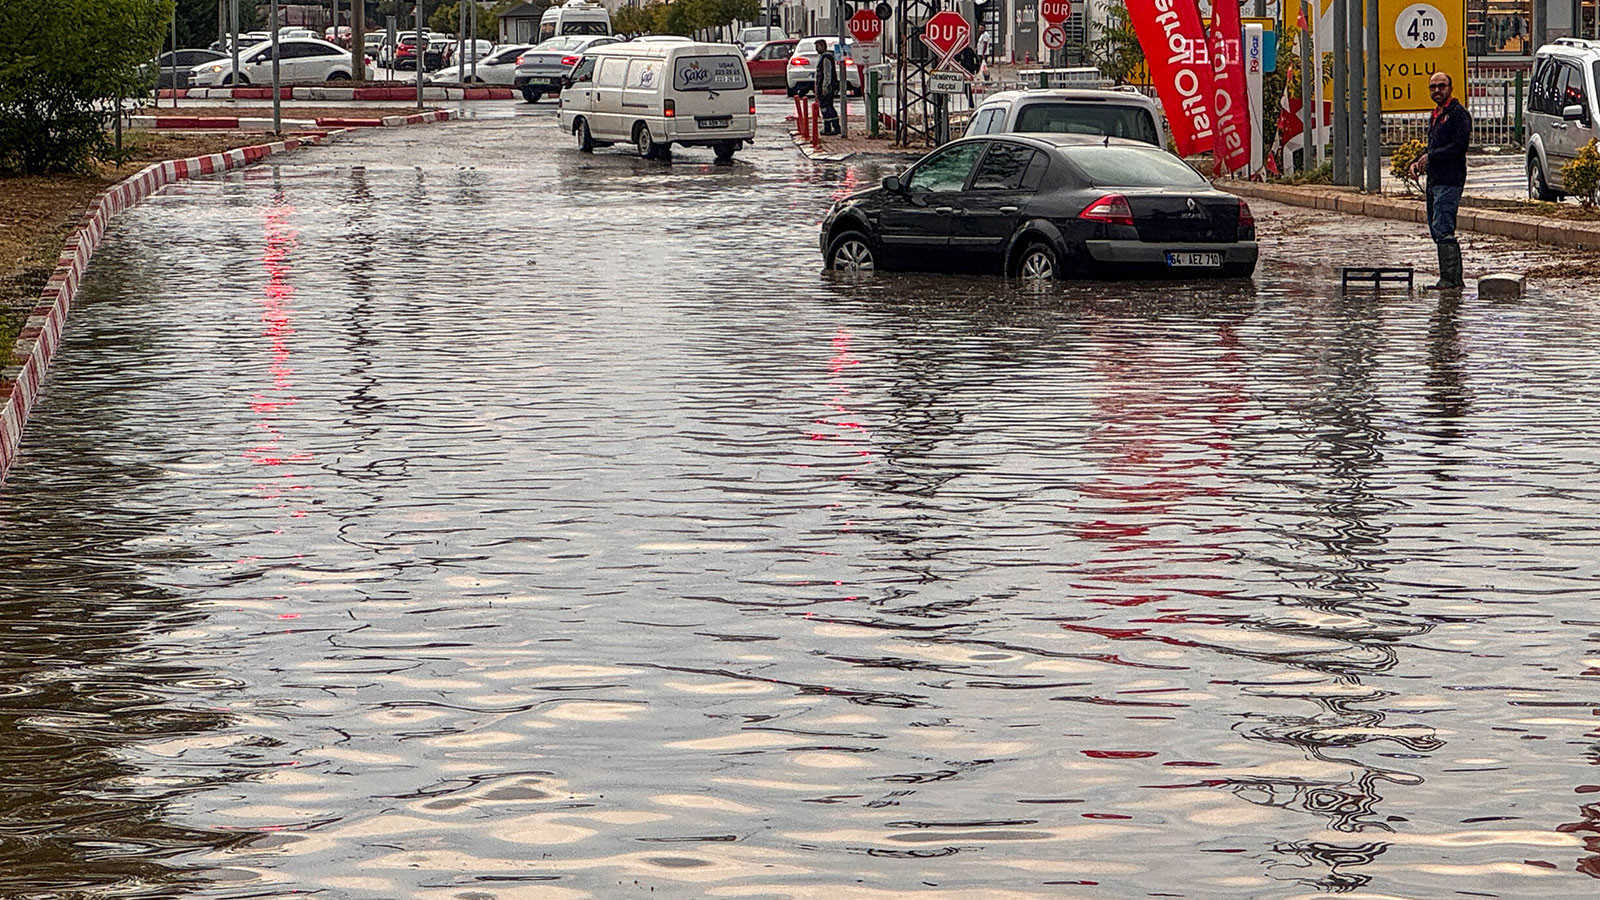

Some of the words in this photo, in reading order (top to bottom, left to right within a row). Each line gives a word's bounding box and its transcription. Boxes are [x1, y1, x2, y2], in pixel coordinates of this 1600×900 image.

[1043, 3, 1068, 16] DUR
[852, 19, 879, 32] DUR
[1407, 18, 1420, 41] 4
[1422, 18, 1433, 26] m
[1384, 62, 1435, 76] YOLU
[1171, 253, 1181, 265] 64
[1189, 253, 1203, 265] AEZ
